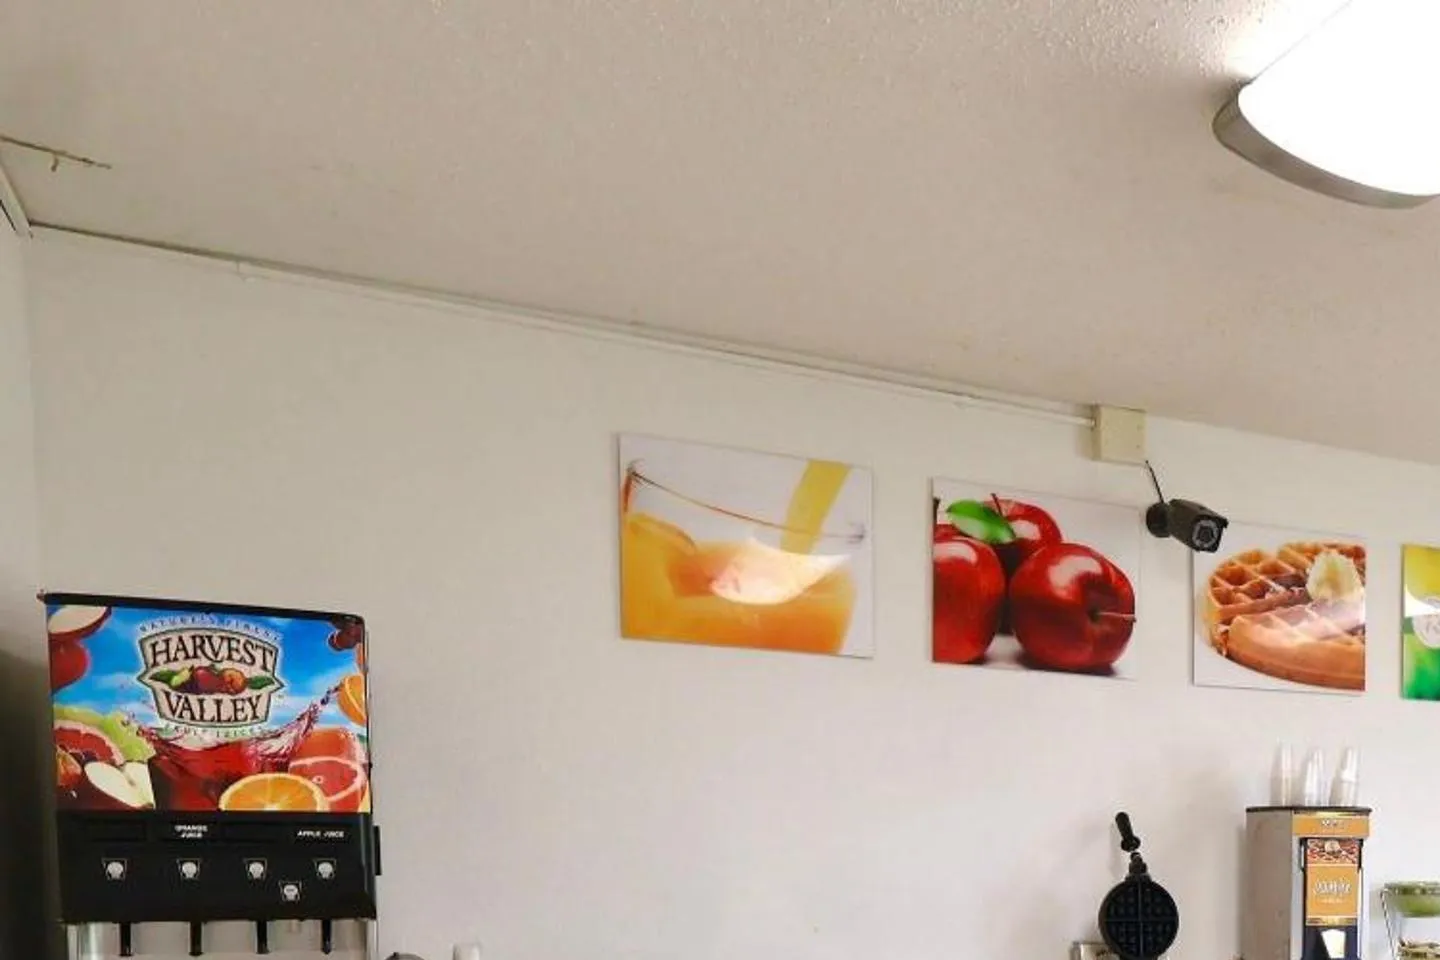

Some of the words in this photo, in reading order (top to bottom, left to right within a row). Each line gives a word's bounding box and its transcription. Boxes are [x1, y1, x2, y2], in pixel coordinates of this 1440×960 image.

[150, 633, 274, 674] HARVEST
[162, 689, 263, 723] VALLEY
[297, 830, 321, 838] APPLE
[322, 830, 345, 838] JUICE
